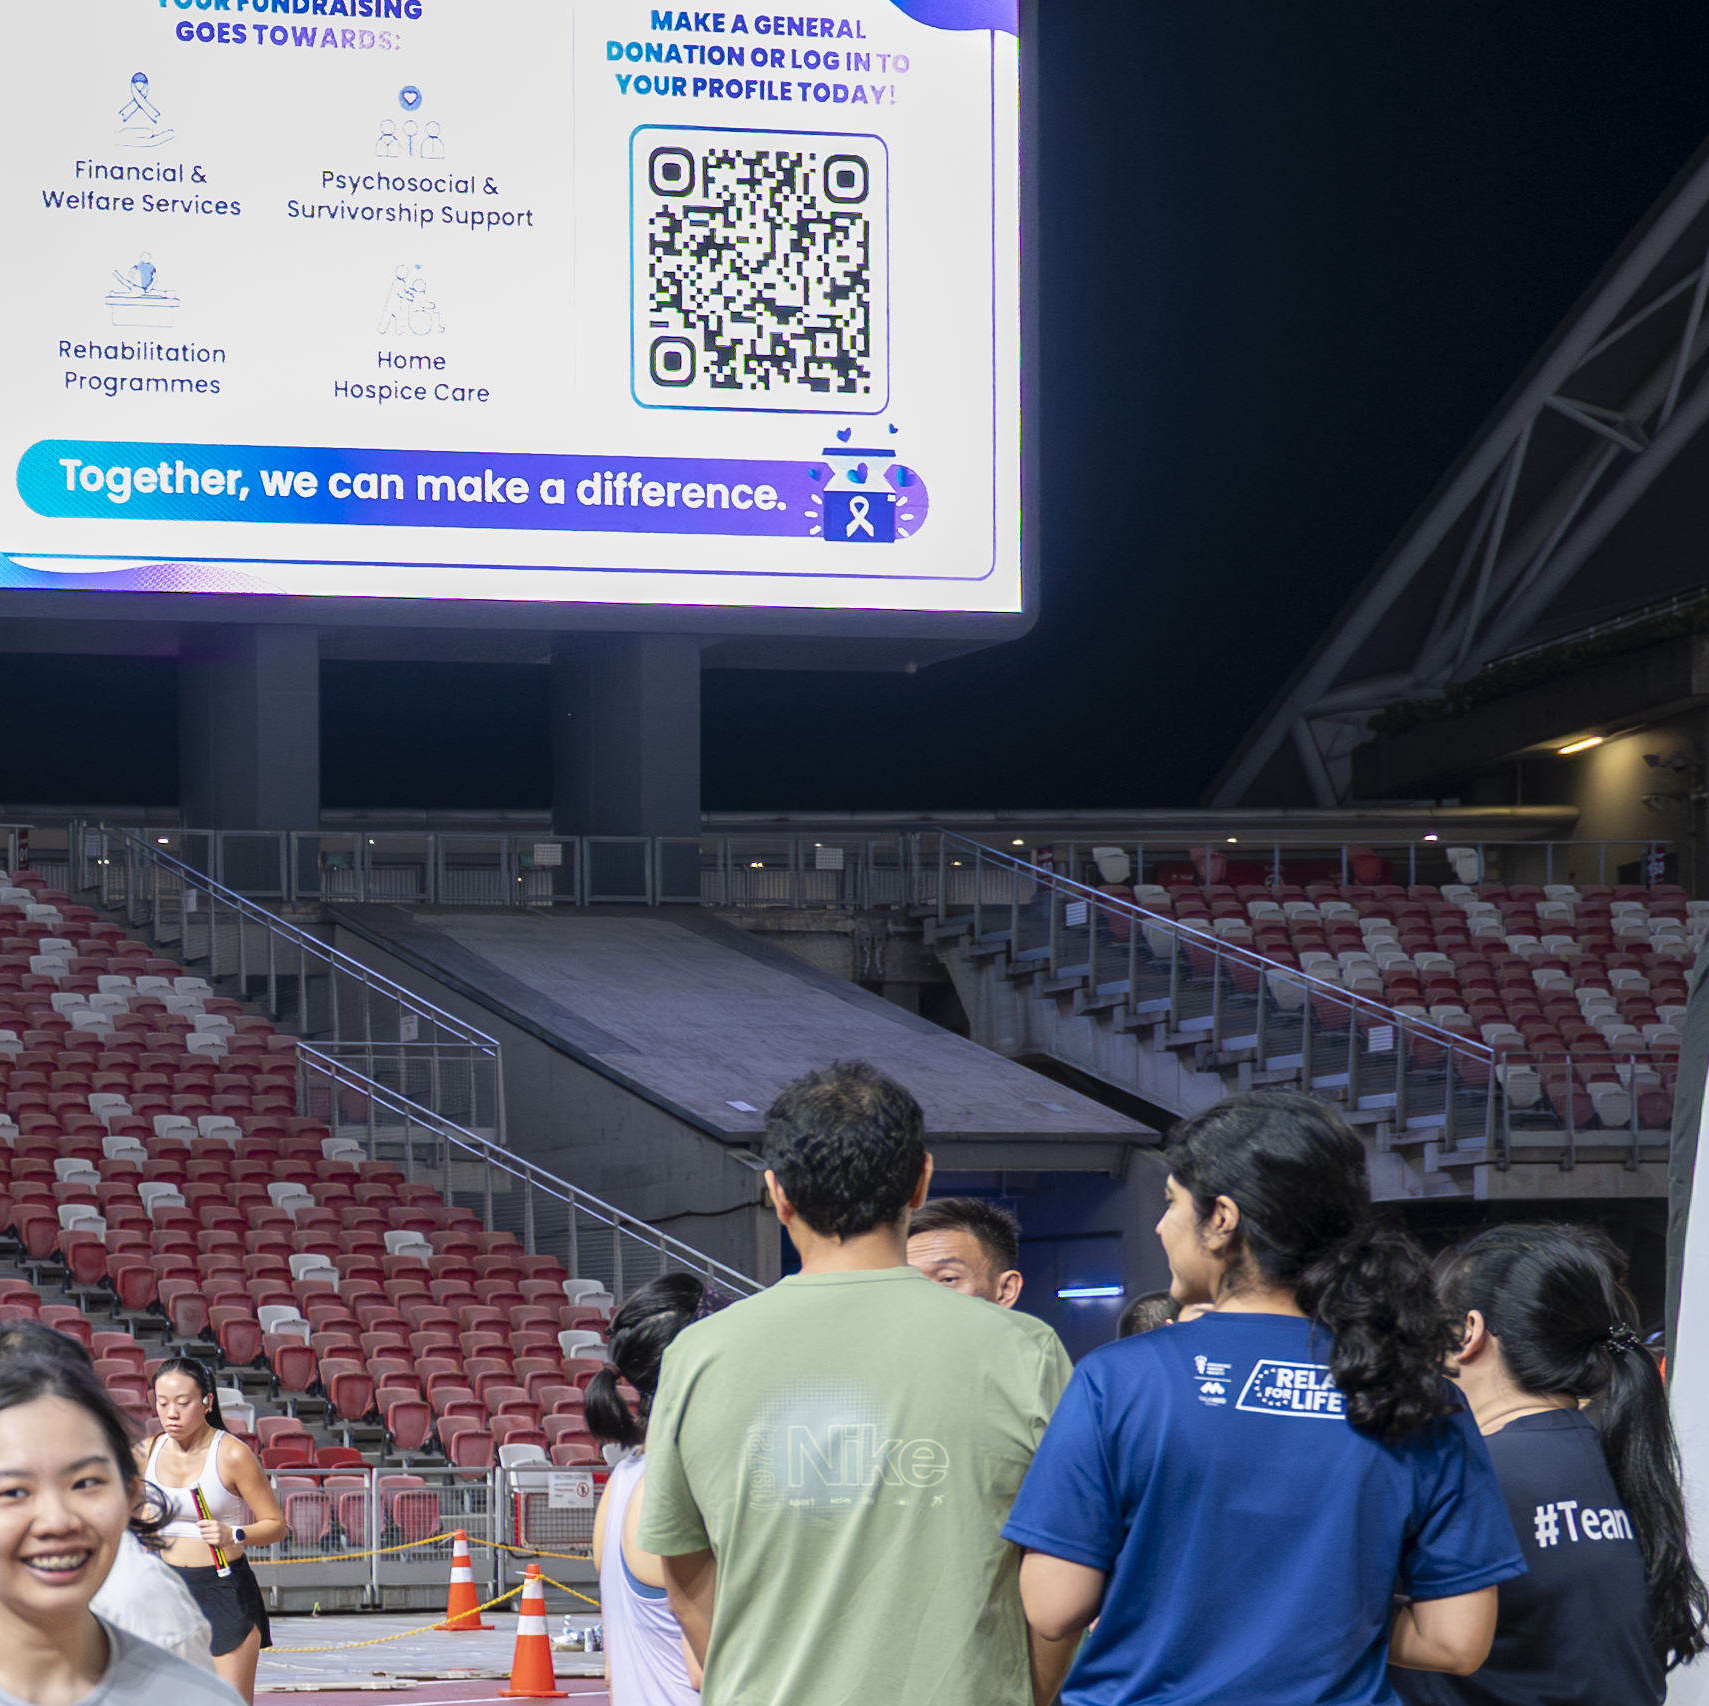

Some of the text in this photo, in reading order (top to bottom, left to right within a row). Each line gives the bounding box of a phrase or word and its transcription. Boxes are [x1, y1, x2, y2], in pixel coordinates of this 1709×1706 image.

[236, 0, 423, 20] FUNDRAISING
[176, 21, 402, 51] GOES TOWARDS:
[650, 10, 867, 39] MAKE A GENERAL
[606, 40, 911, 74] DONATION OR LOG IN TO
[615, 74, 896, 106] YOUR PROFILE TODAY!
[76, 159, 208, 183] Financial &
[322, 171, 500, 196] Psychosocial &
[42, 190, 242, 216] Welfare Services
[287, 200, 534, 232] Survivorship Support
[59, 340, 226, 364] Rehabilitation
[378, 351, 447, 371] Home
[65, 372, 221, 397] Programmes
[334, 380, 490, 405] Hospice Care
[59, 458, 787, 511] Together, we can make a difference.
[1276, 1368, 1335, 1390] RELA
[1265, 1387, 1343, 1412] FOR LIFE
[746, 1422, 780, 1512] (1972)
[788, 1424, 950, 1487] Nike
